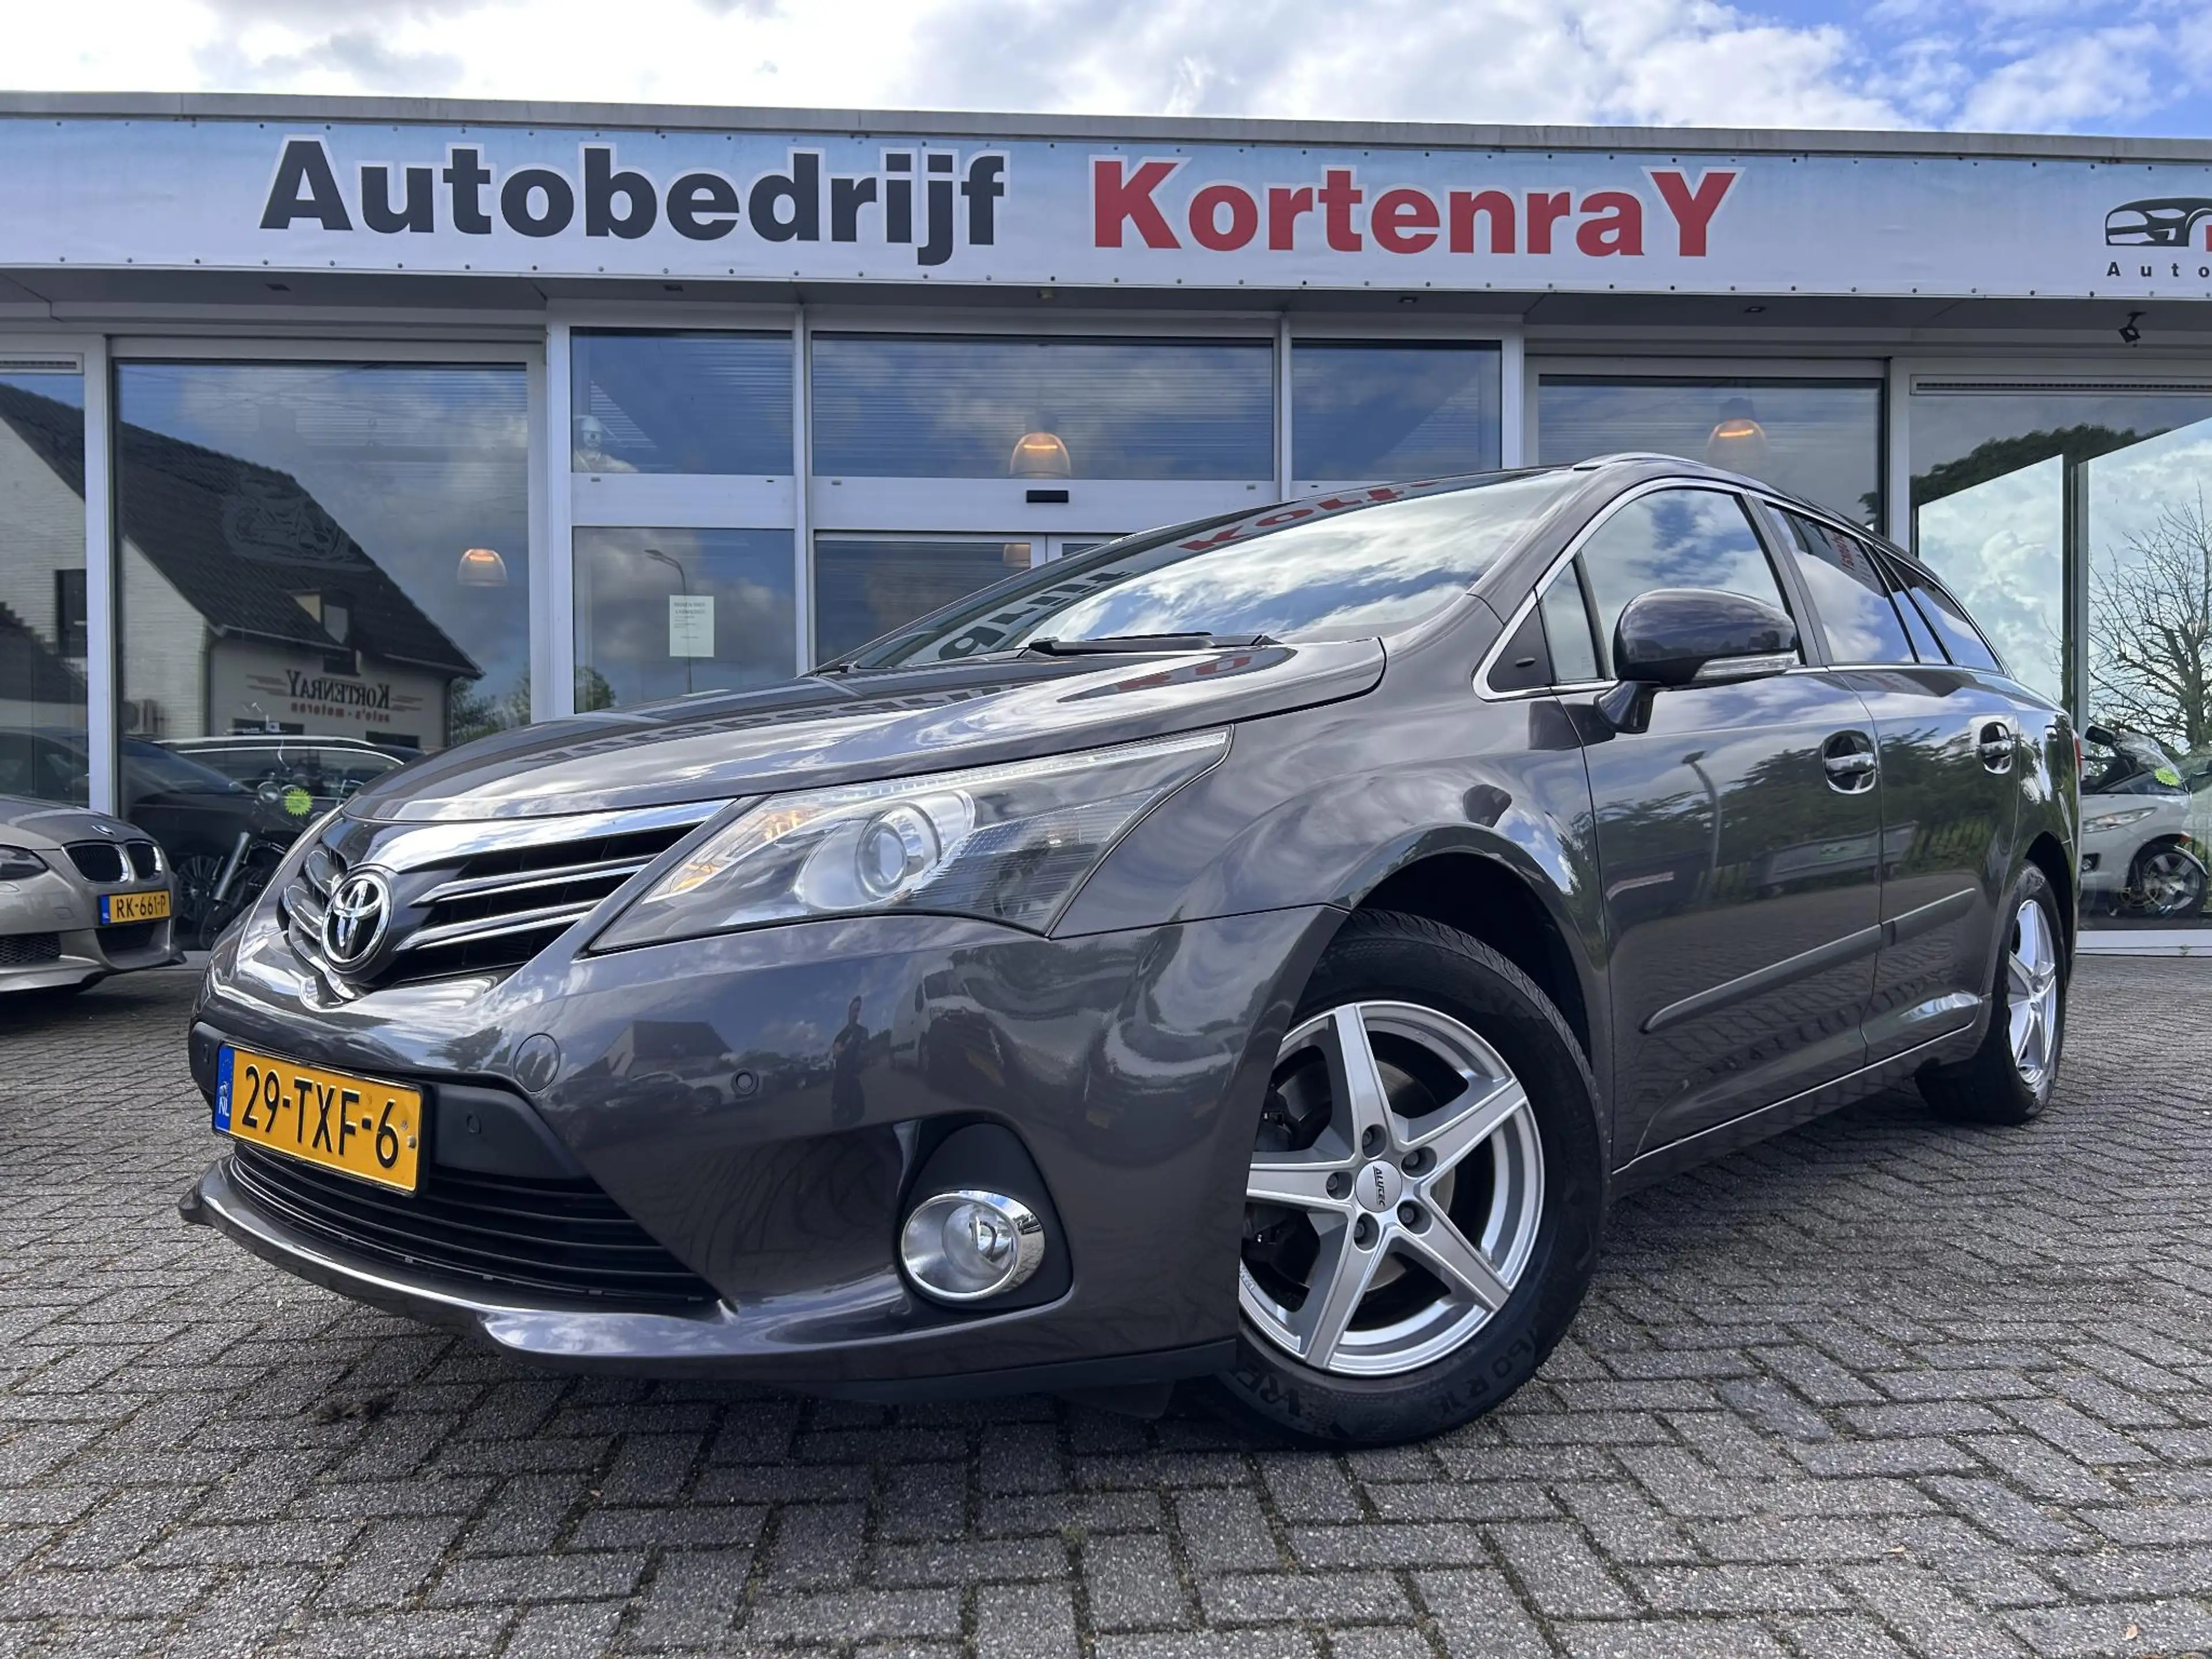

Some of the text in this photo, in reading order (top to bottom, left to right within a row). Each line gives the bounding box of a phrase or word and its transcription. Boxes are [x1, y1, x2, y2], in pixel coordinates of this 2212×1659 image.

[260, 139, 1736, 266] Autobedrijf KortenraY
[116, 894, 166, 919] RK-661-P
[218, 1096, 230, 1117] NL
[241, 1064, 399, 1169] 29-TXF-6
